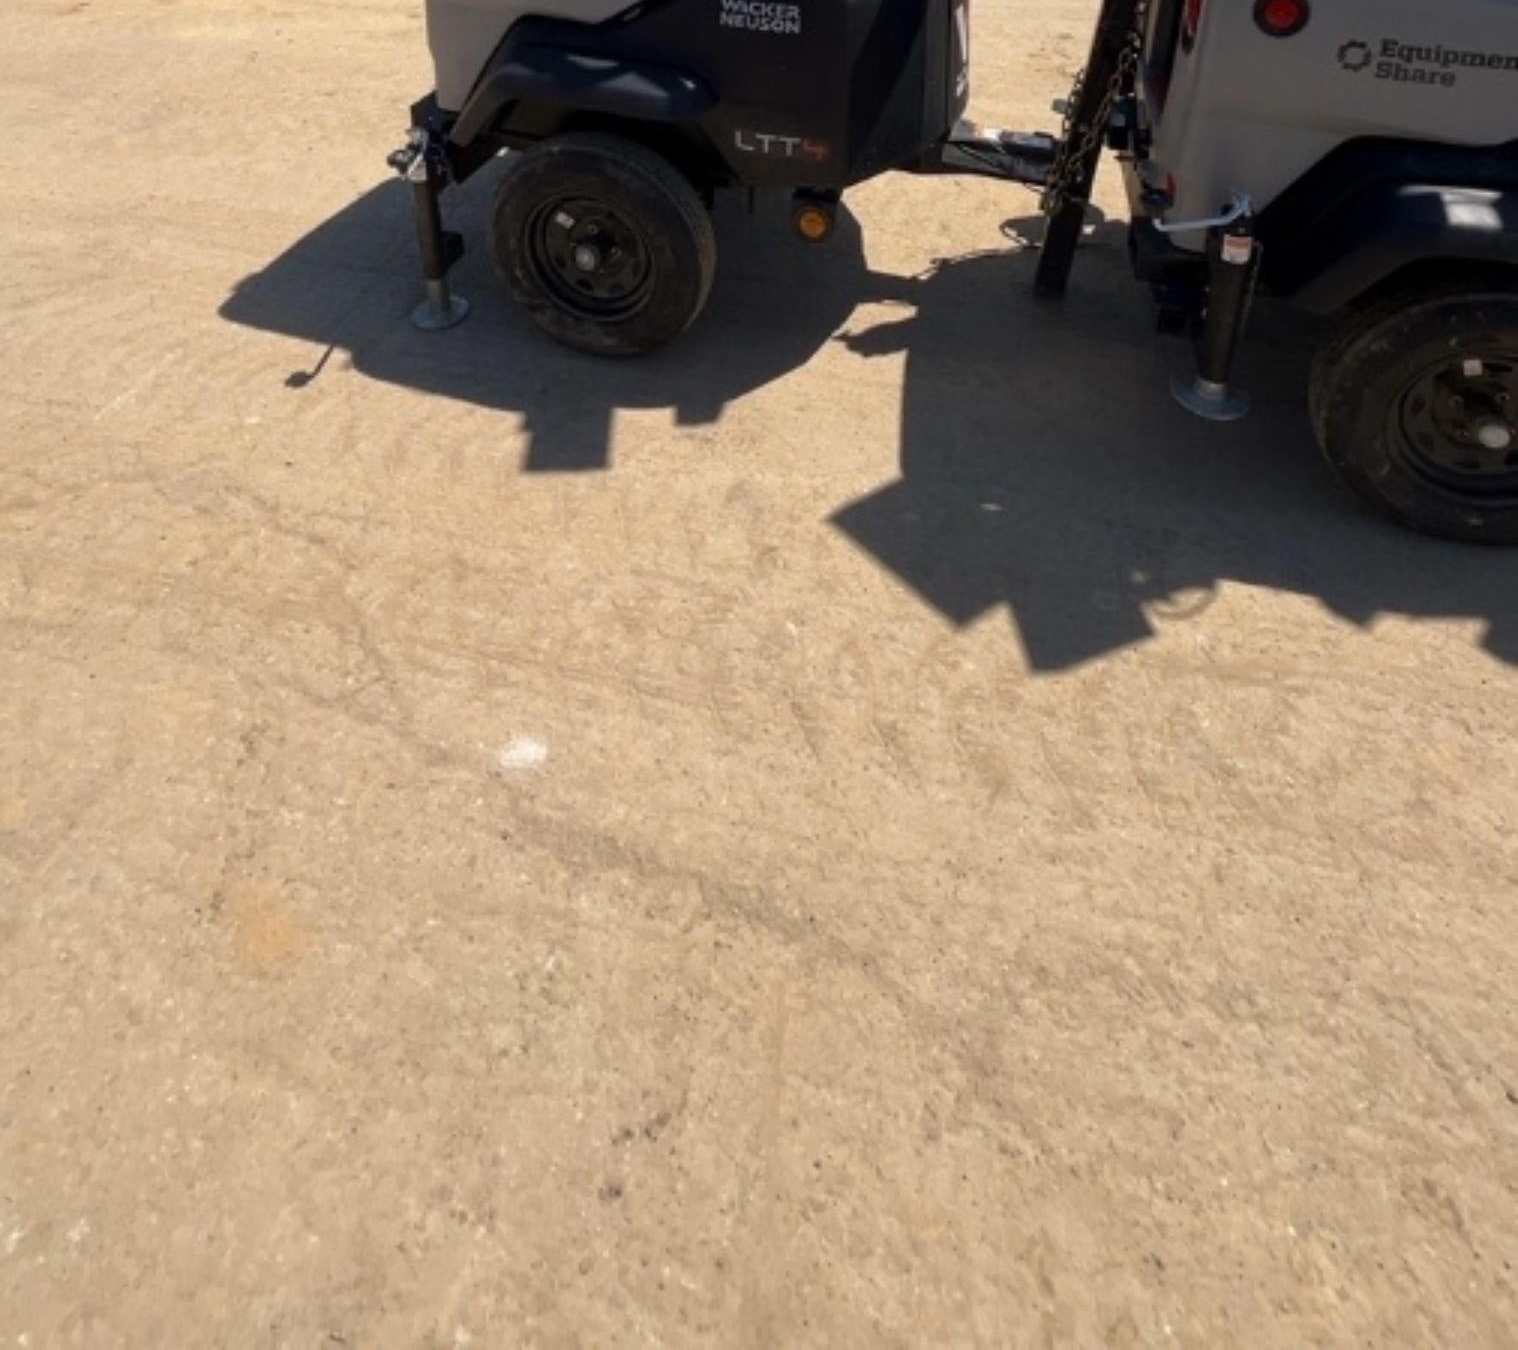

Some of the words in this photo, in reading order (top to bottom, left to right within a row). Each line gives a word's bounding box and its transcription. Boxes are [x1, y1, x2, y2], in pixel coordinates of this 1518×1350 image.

[719, 12, 801, 34] NEUSON
[1379, 38, 1518, 70] Equipmen
[1374, 60, 1457, 88] Share
[733, 129, 829, 160] LTT4
